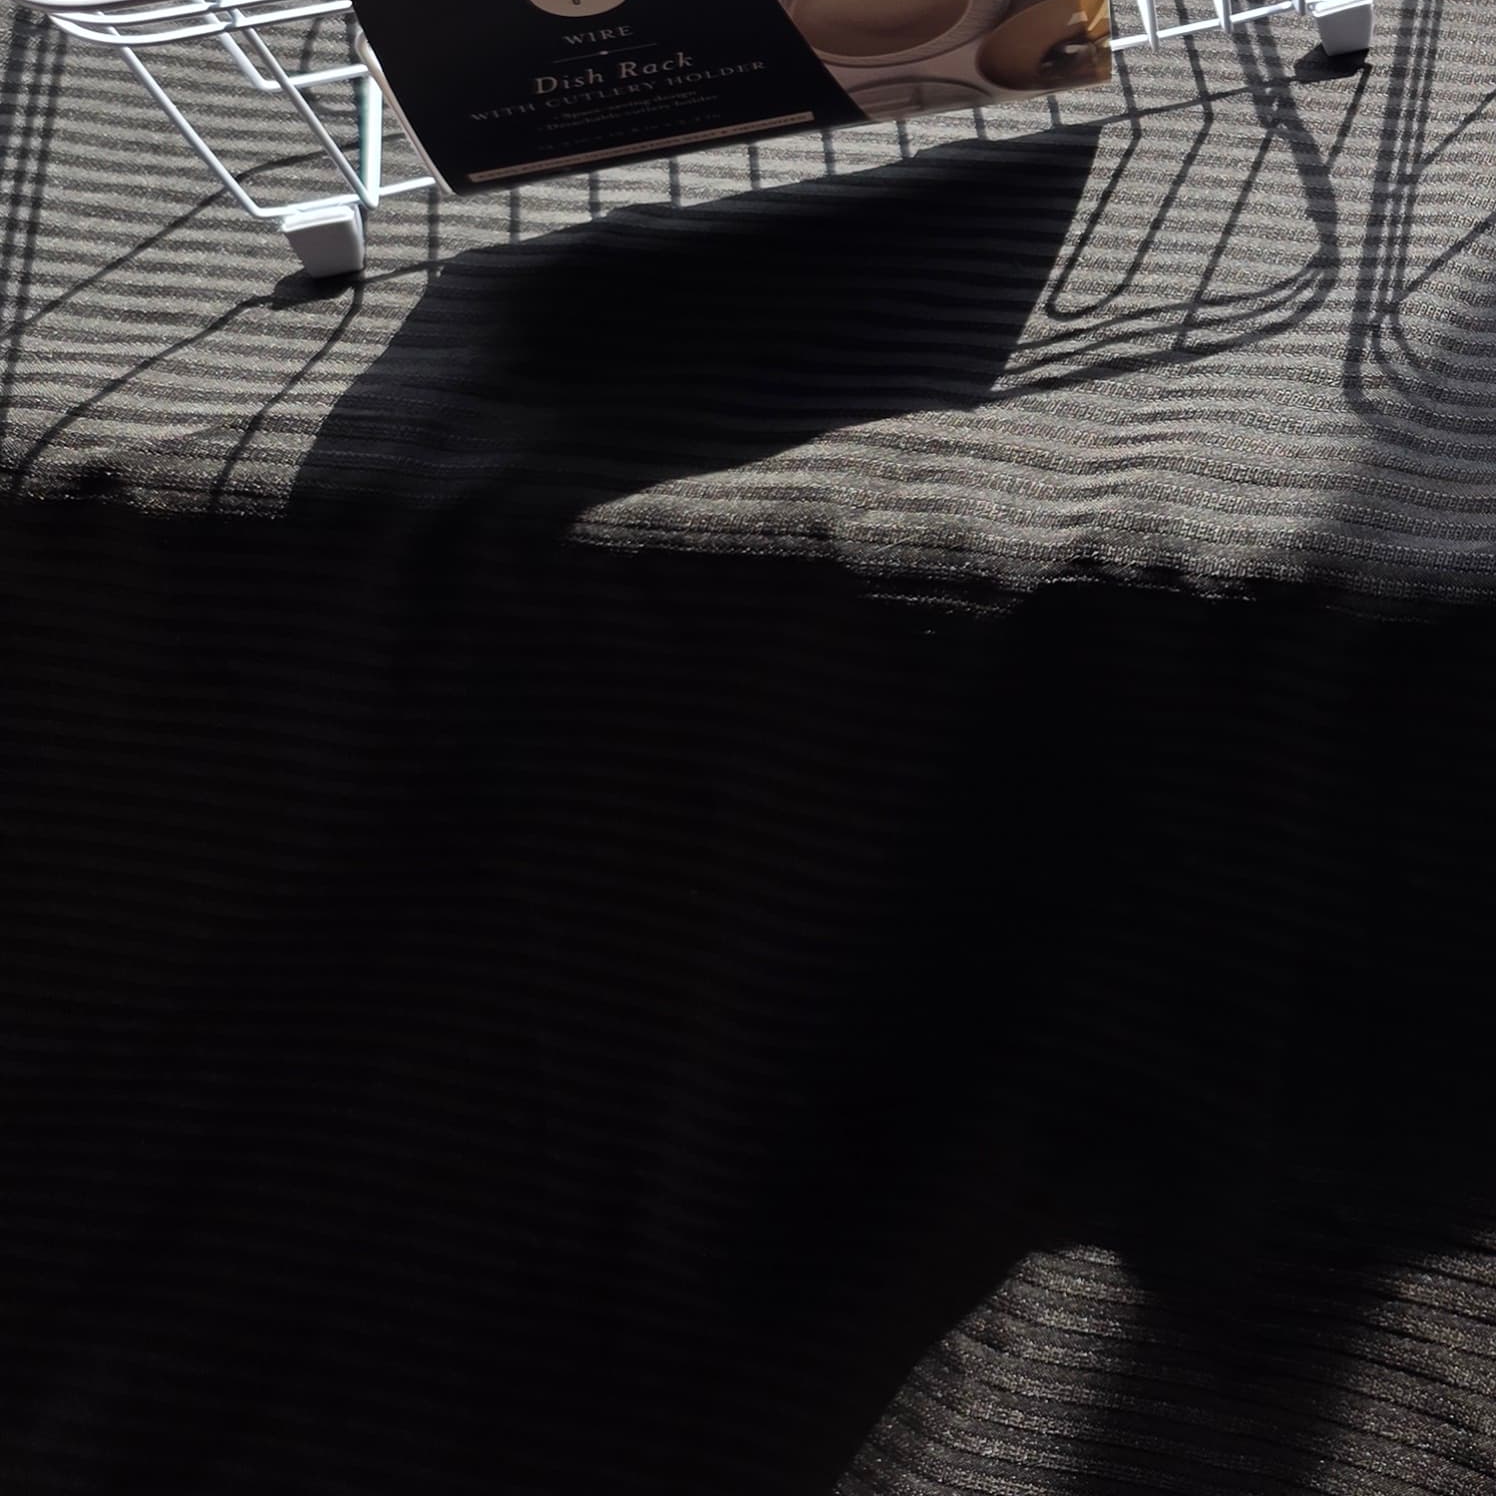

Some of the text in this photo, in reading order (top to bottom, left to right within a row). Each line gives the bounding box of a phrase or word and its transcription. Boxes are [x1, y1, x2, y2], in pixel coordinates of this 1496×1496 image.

[561, 25, 633, 45] WIRE
[468, 60, 768, 121] WITH CUTLERY HOLDER
[533, 51, 694, 96] Dish Rack
